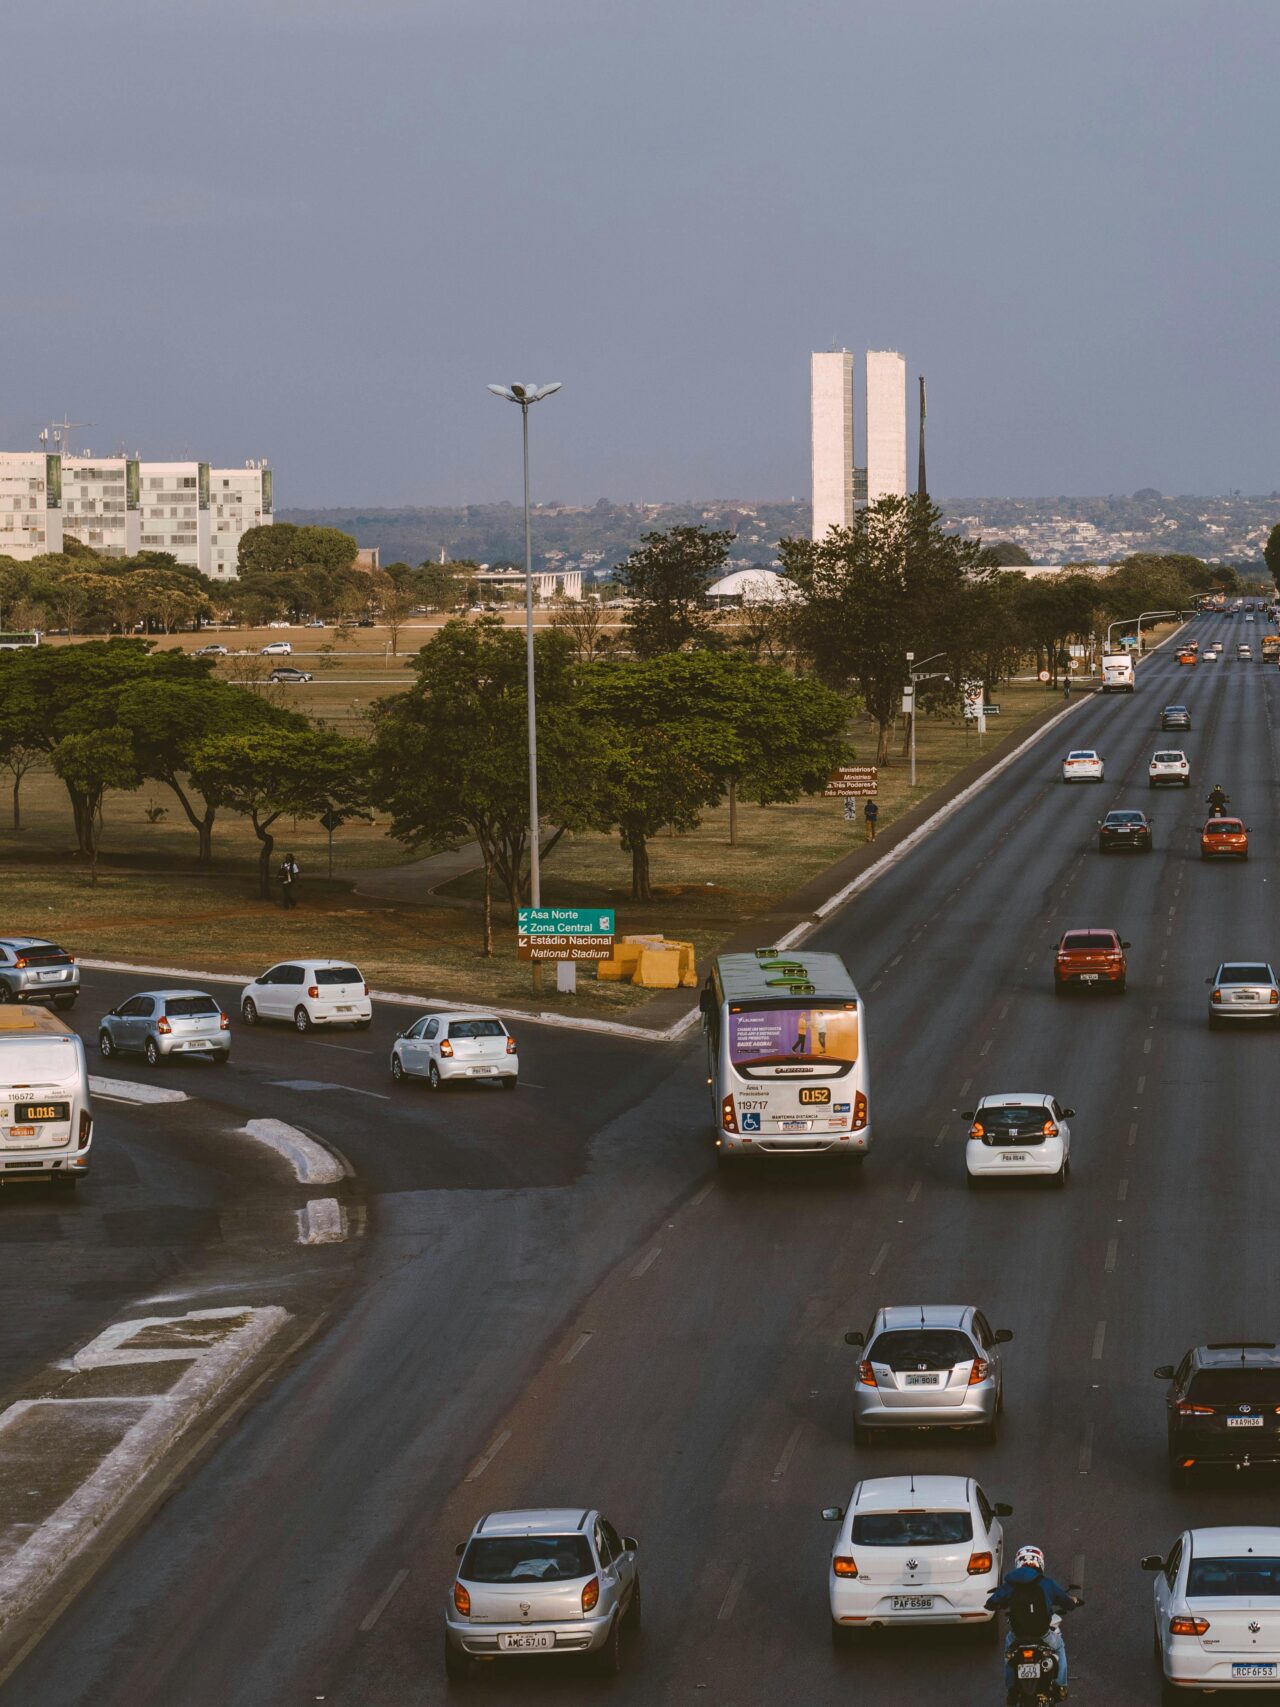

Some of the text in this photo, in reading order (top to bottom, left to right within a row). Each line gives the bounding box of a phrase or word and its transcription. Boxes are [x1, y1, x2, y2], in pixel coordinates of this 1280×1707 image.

[530, 911, 578, 919] Asa Norte
[530, 923, 593, 932] Zona Central
[530, 936, 612, 945] Estádio Nacional
[530, 949, 609, 958] National Stadium
[802, 1090, 829, 1102] 0.152
[737, 1101, 768, 1110] 119717
[27, 1107, 55, 1119] 0.016
[1236, 1667, 1273, 1676] RCF6F53
